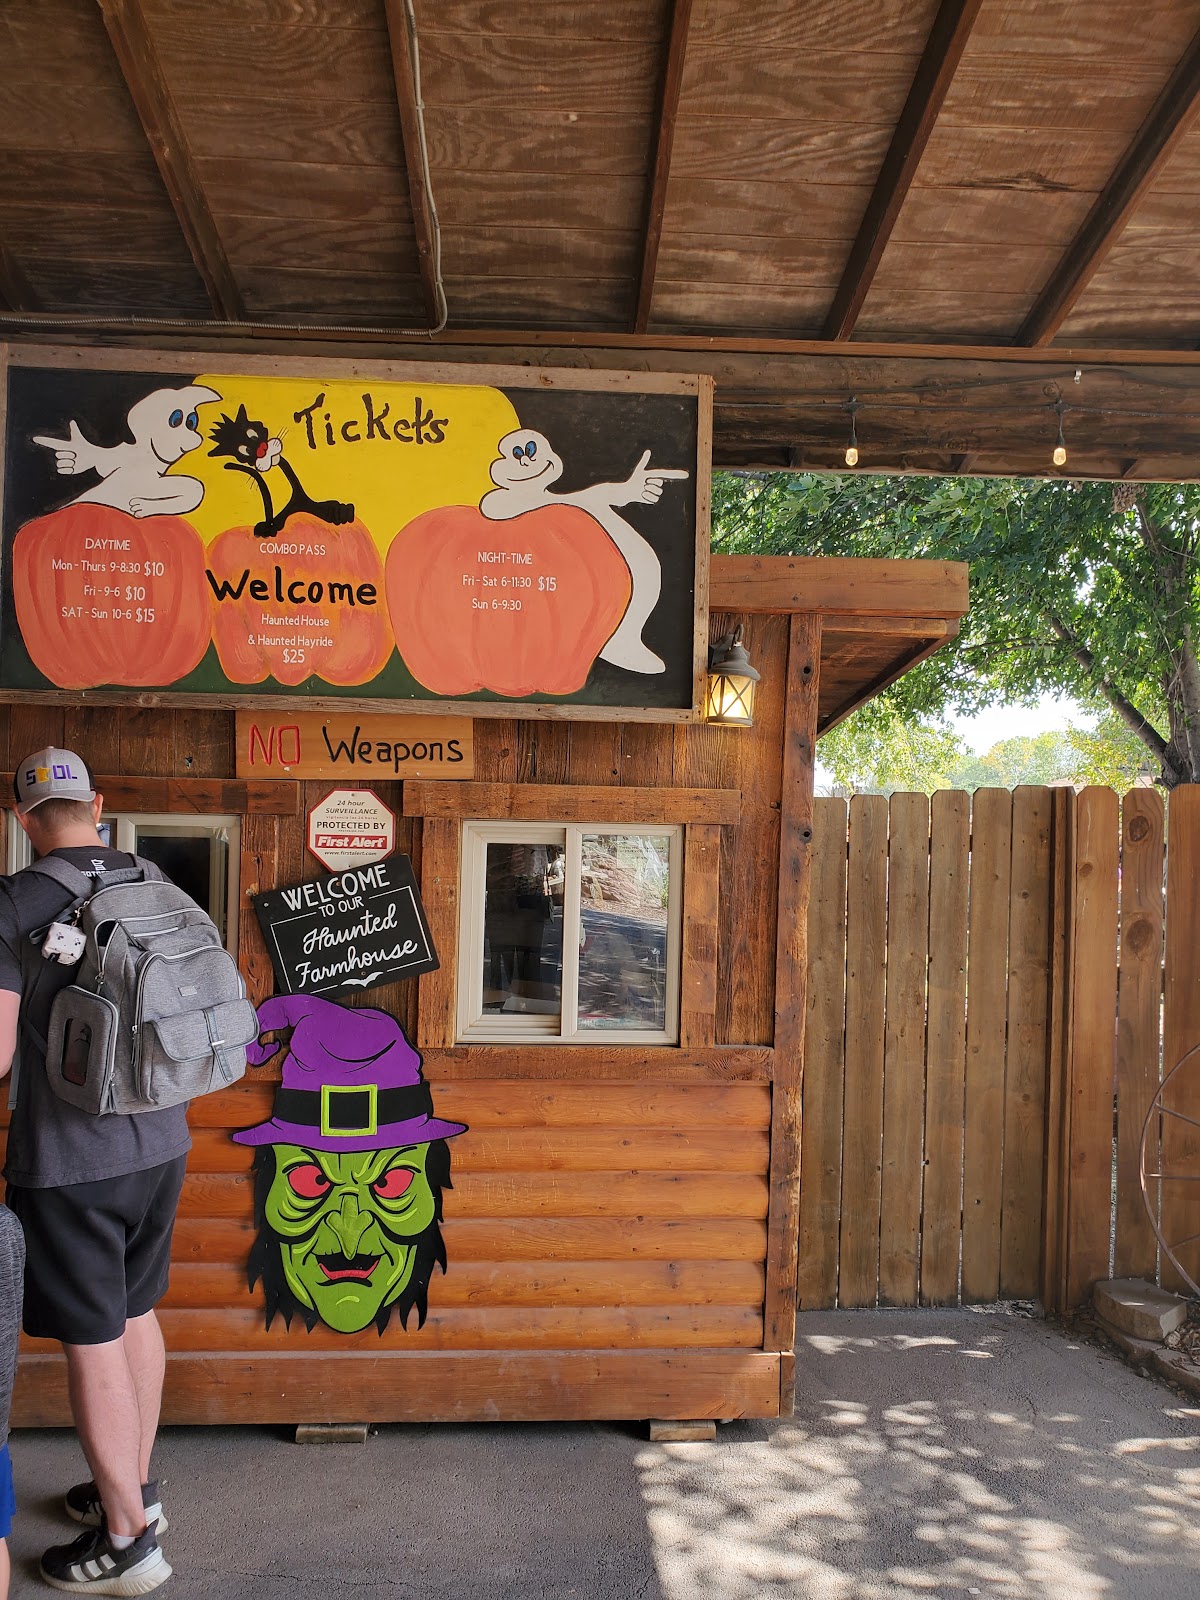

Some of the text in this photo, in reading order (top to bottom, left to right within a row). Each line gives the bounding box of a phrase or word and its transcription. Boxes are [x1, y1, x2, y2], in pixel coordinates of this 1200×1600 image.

[293, 392, 449, 449] Tickets
[85, 538, 131, 551] DAYTIME
[260, 542, 326, 555] COMBO PASS
[477, 552, 532, 564] NIGHT-TIME
[109, 561, 140, 573] 9-8:30
[143, 561, 164, 577] $10
[205, 566, 377, 606] Welcome
[501, 577, 532, 588] 6-11:30
[538, 576, 557, 591] $15
[125, 586, 146, 601] $10
[472, 598, 522, 611] Sun 6-9:30
[112, 608, 132, 619] 10-6
[135, 607, 155, 623] $15
[261, 614, 330, 627] Haunted House
[248, 635, 333, 649] & Haunted Hayride
[282, 648, 305, 664] $25
[248, 724, 464, 773] NO Weapons
[317, 821, 370, 830] PROTECTED
[317, 836, 385, 848] First Alert
[281, 864, 390, 911] WELCOME
[318, 896, 364, 917] TO OUR
[302, 903, 398, 955] Haunted
[295, 938, 418, 988] Farmhouse
